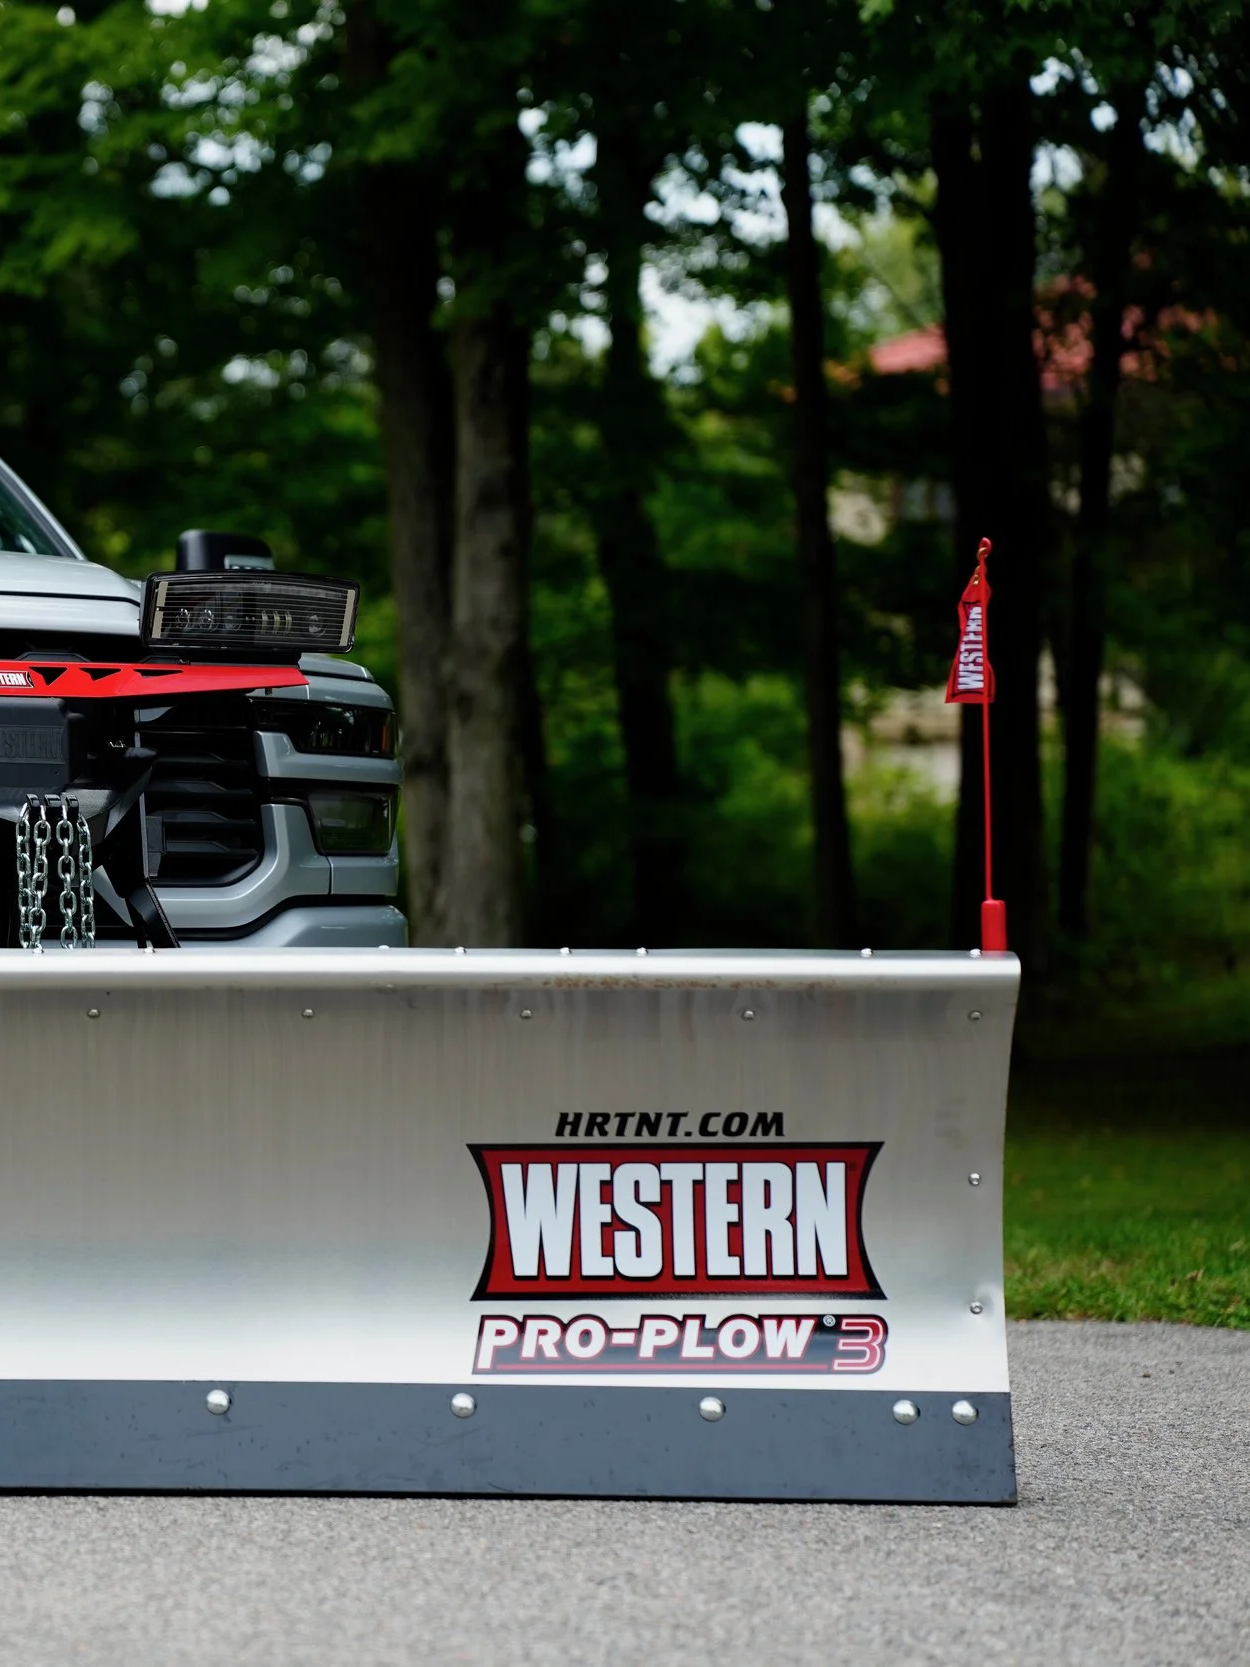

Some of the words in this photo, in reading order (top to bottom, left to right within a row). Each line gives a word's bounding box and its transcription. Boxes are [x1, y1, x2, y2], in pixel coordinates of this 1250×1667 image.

[957, 606, 985, 690] WESTERN
[555, 1111, 786, 1138] HRTNT.COM
[500, 1161, 849, 1281] WESTERN
[832, 1318, 887, 1372] 3
